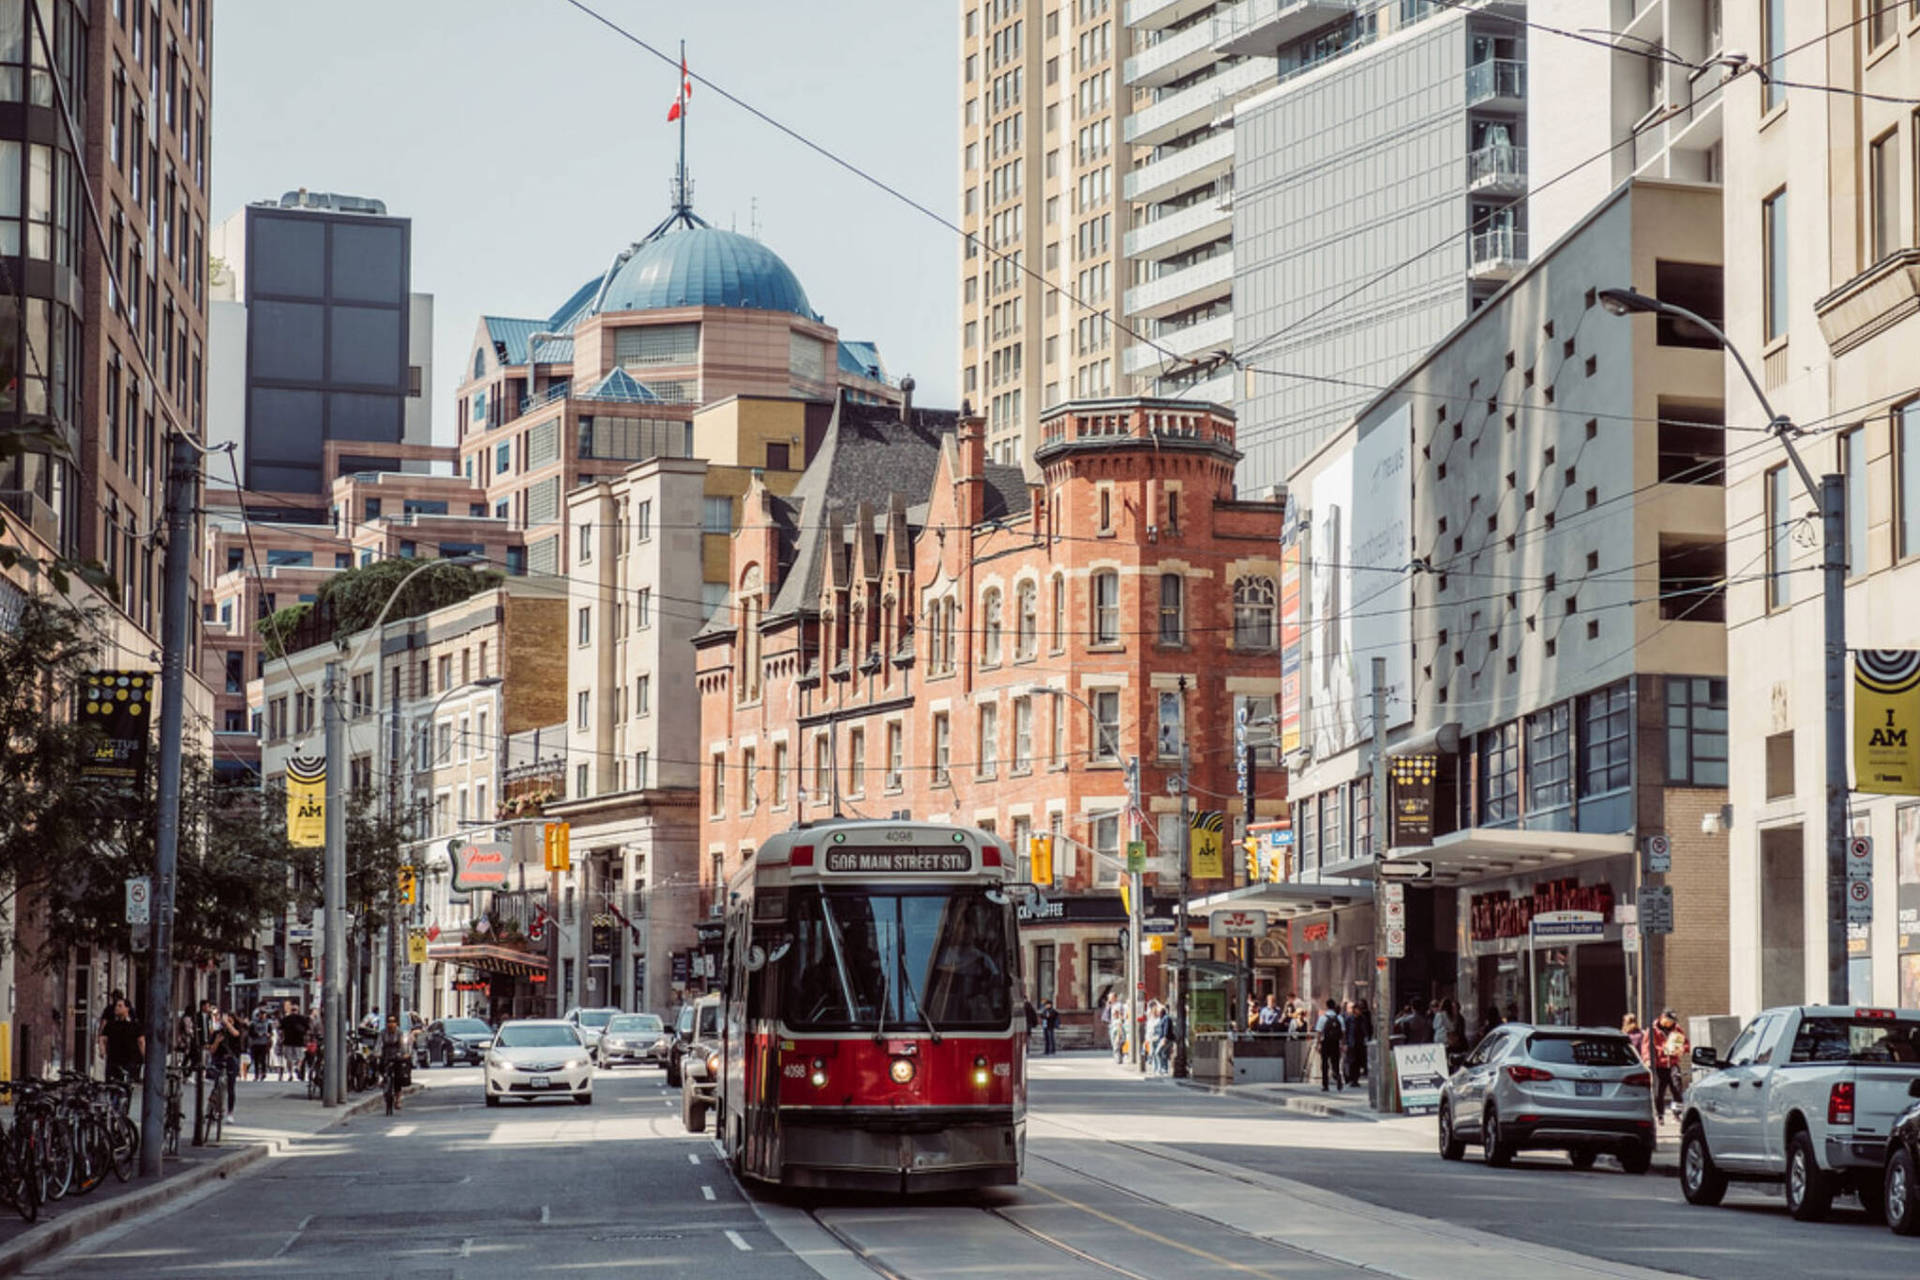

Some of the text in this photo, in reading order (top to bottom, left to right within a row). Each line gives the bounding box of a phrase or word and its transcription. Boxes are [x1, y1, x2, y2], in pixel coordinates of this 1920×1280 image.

[1886, 709, 1895, 727] I
[1869, 728, 1907, 747] AM
[308, 793, 313, 804] I
[297, 805, 322, 817] AM
[886, 831, 912, 841] 4098
[1199, 848, 1215, 856] AM
[831, 854, 967, 870] 506 MAIN STREET STN
[1226, 927, 1253, 937] Subway
[783, 1064, 806, 1079] 4098
